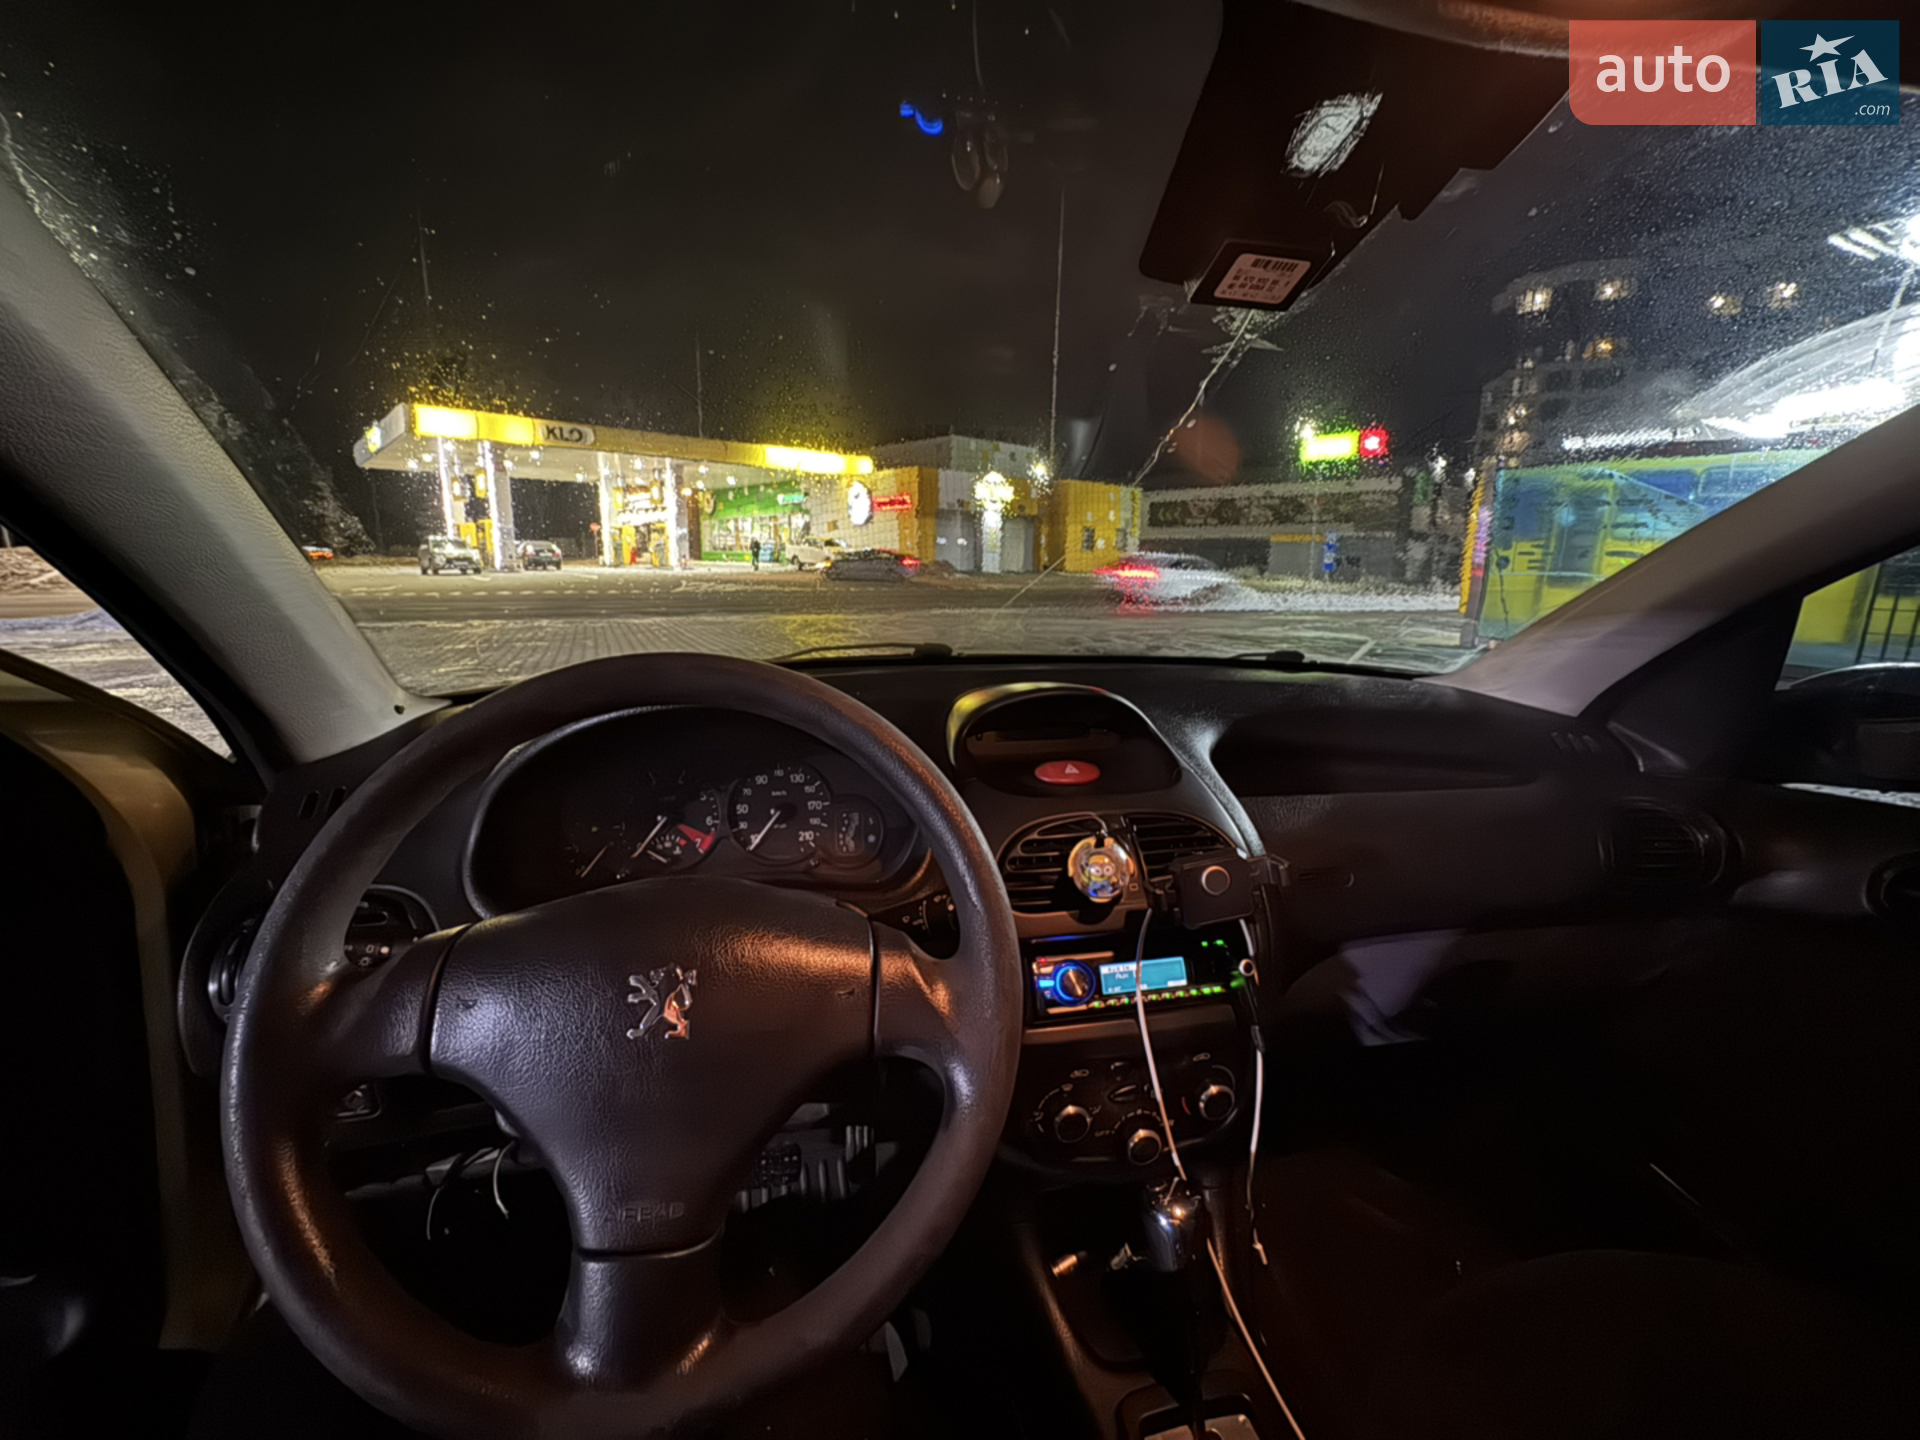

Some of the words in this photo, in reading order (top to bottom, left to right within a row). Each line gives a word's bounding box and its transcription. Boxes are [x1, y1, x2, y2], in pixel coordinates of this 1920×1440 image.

[546, 424, 583, 443] KLO
[774, 769, 784, 777] 110
[755, 775, 768, 785] 90
[789, 773, 805, 784] 130
[743, 788, 752, 796] 70
[804, 785, 816, 793] 150
[736, 804, 749, 815] 50
[807, 801, 822, 810] 170
[705, 815, 713, 826] 6
[738, 821, 748, 829] 30
[797, 830, 814, 842] 210
